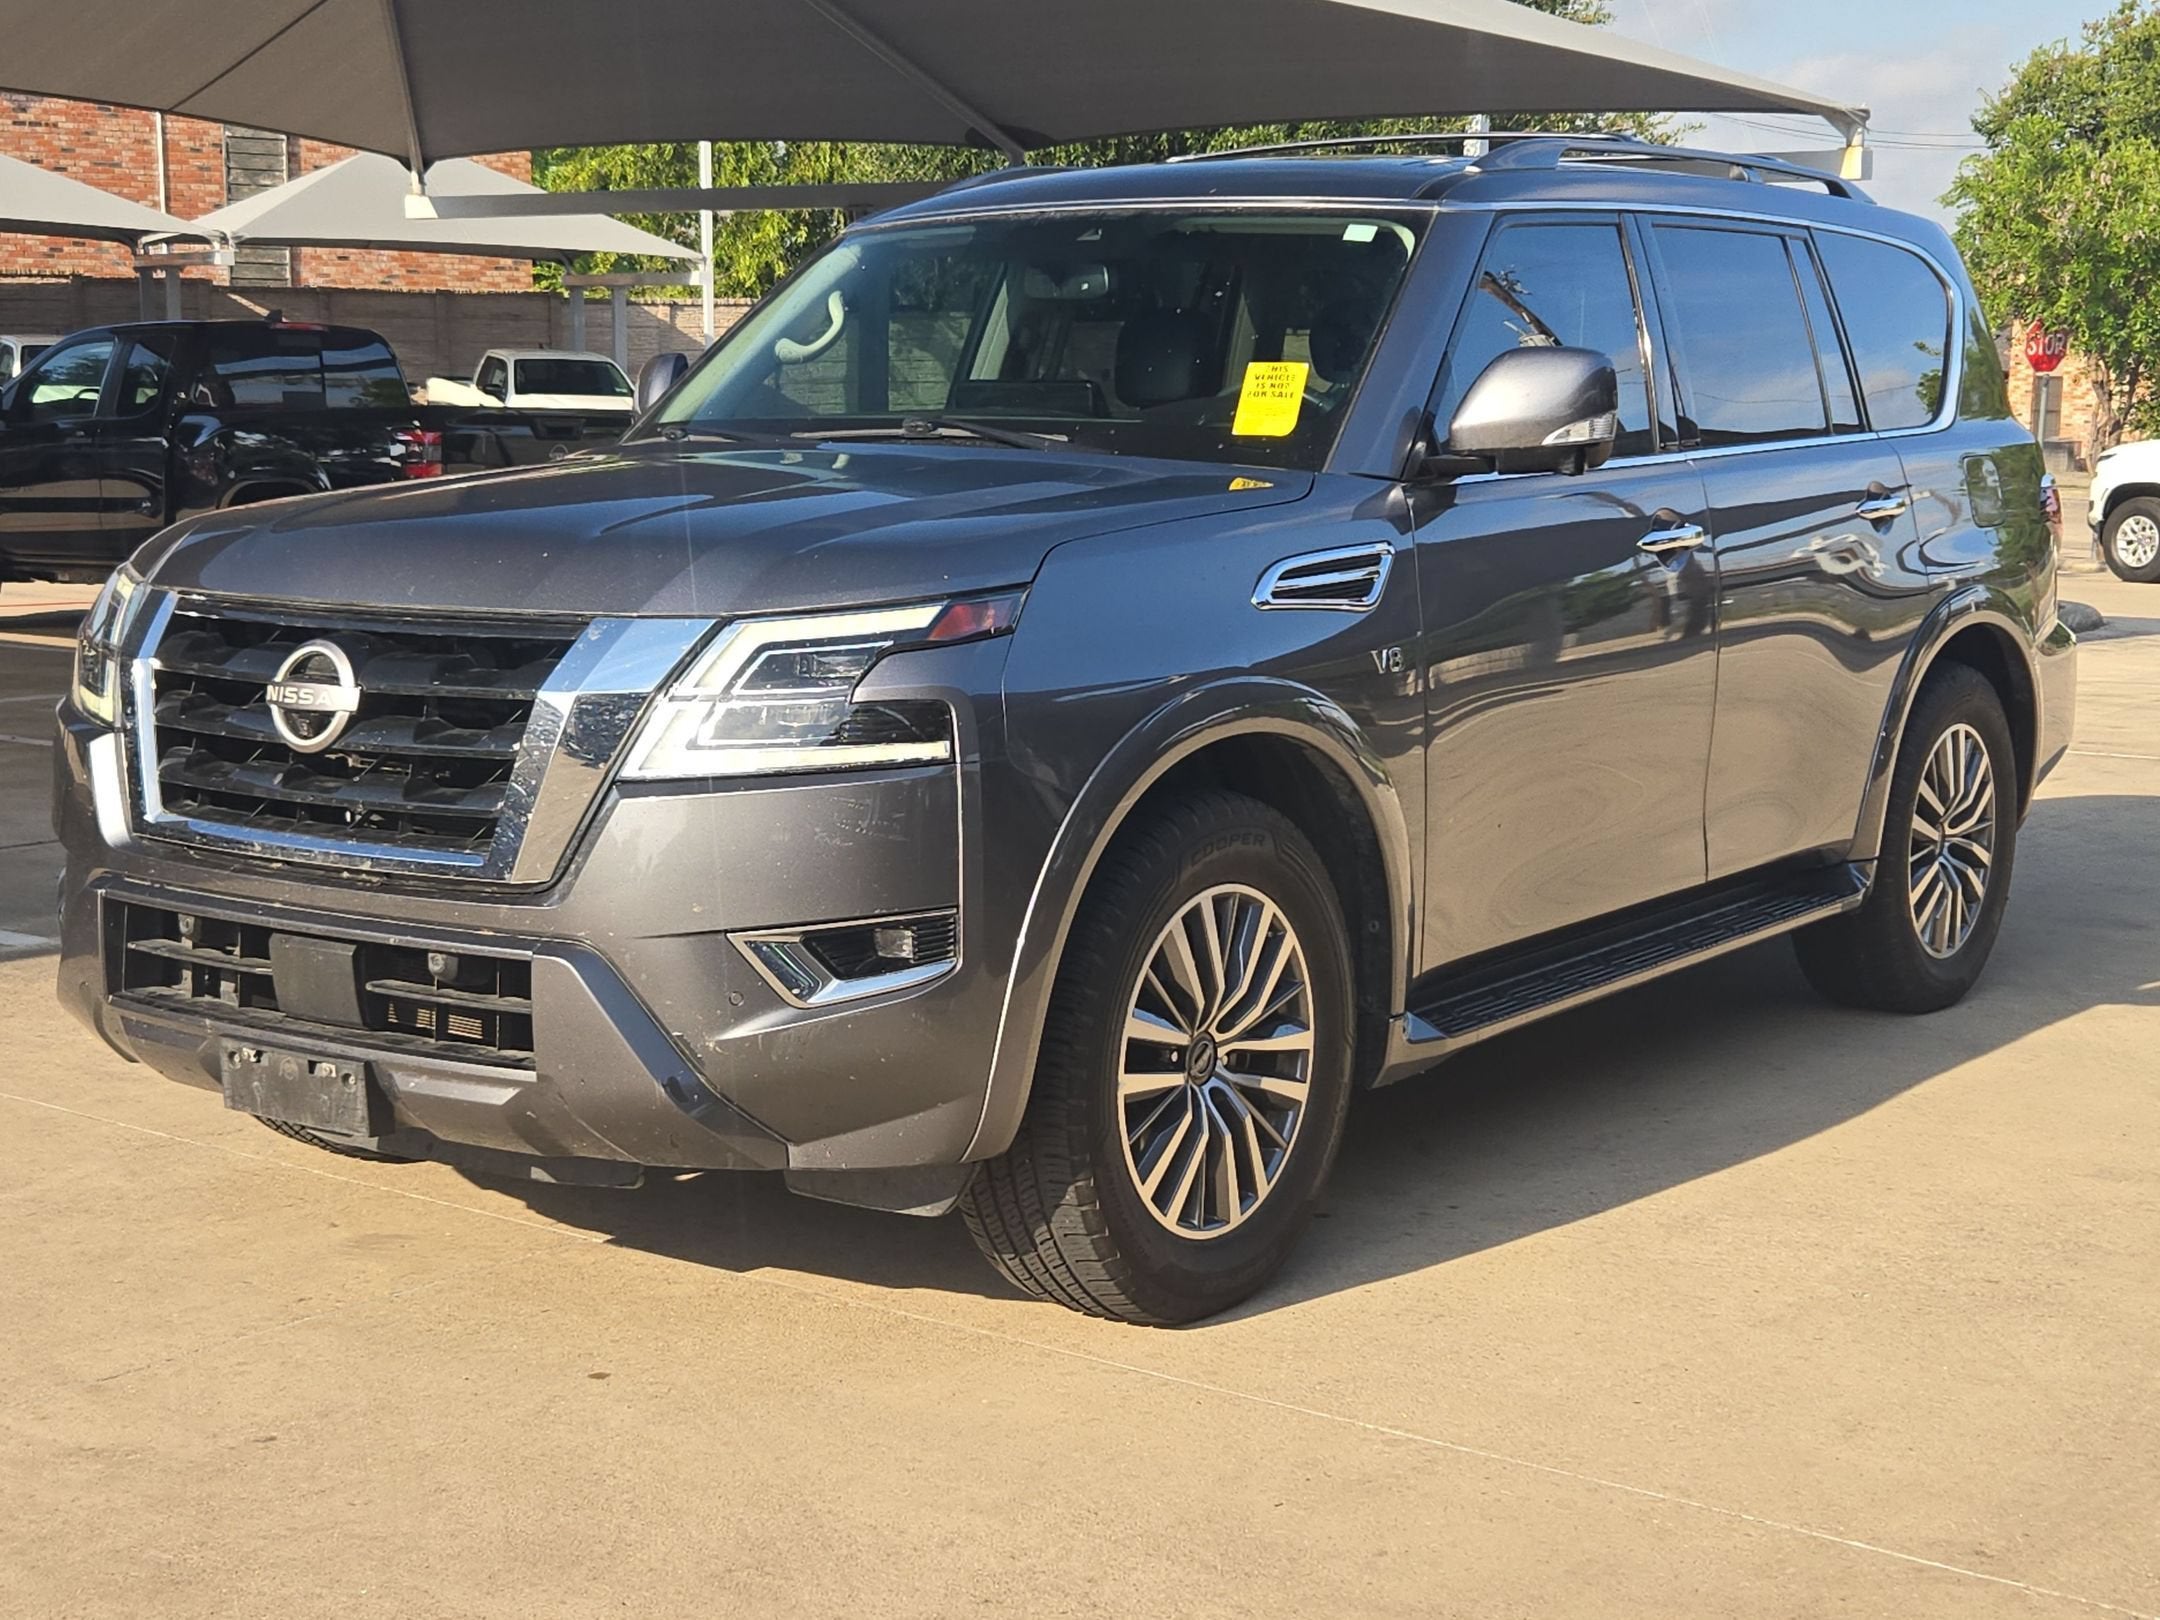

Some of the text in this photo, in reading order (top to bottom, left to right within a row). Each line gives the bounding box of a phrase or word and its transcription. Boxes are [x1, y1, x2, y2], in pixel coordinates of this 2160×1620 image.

[2026, 333, 2066, 356] STOP
[1370, 646, 1405, 674] V8
[266, 684, 354, 707] NISSA
